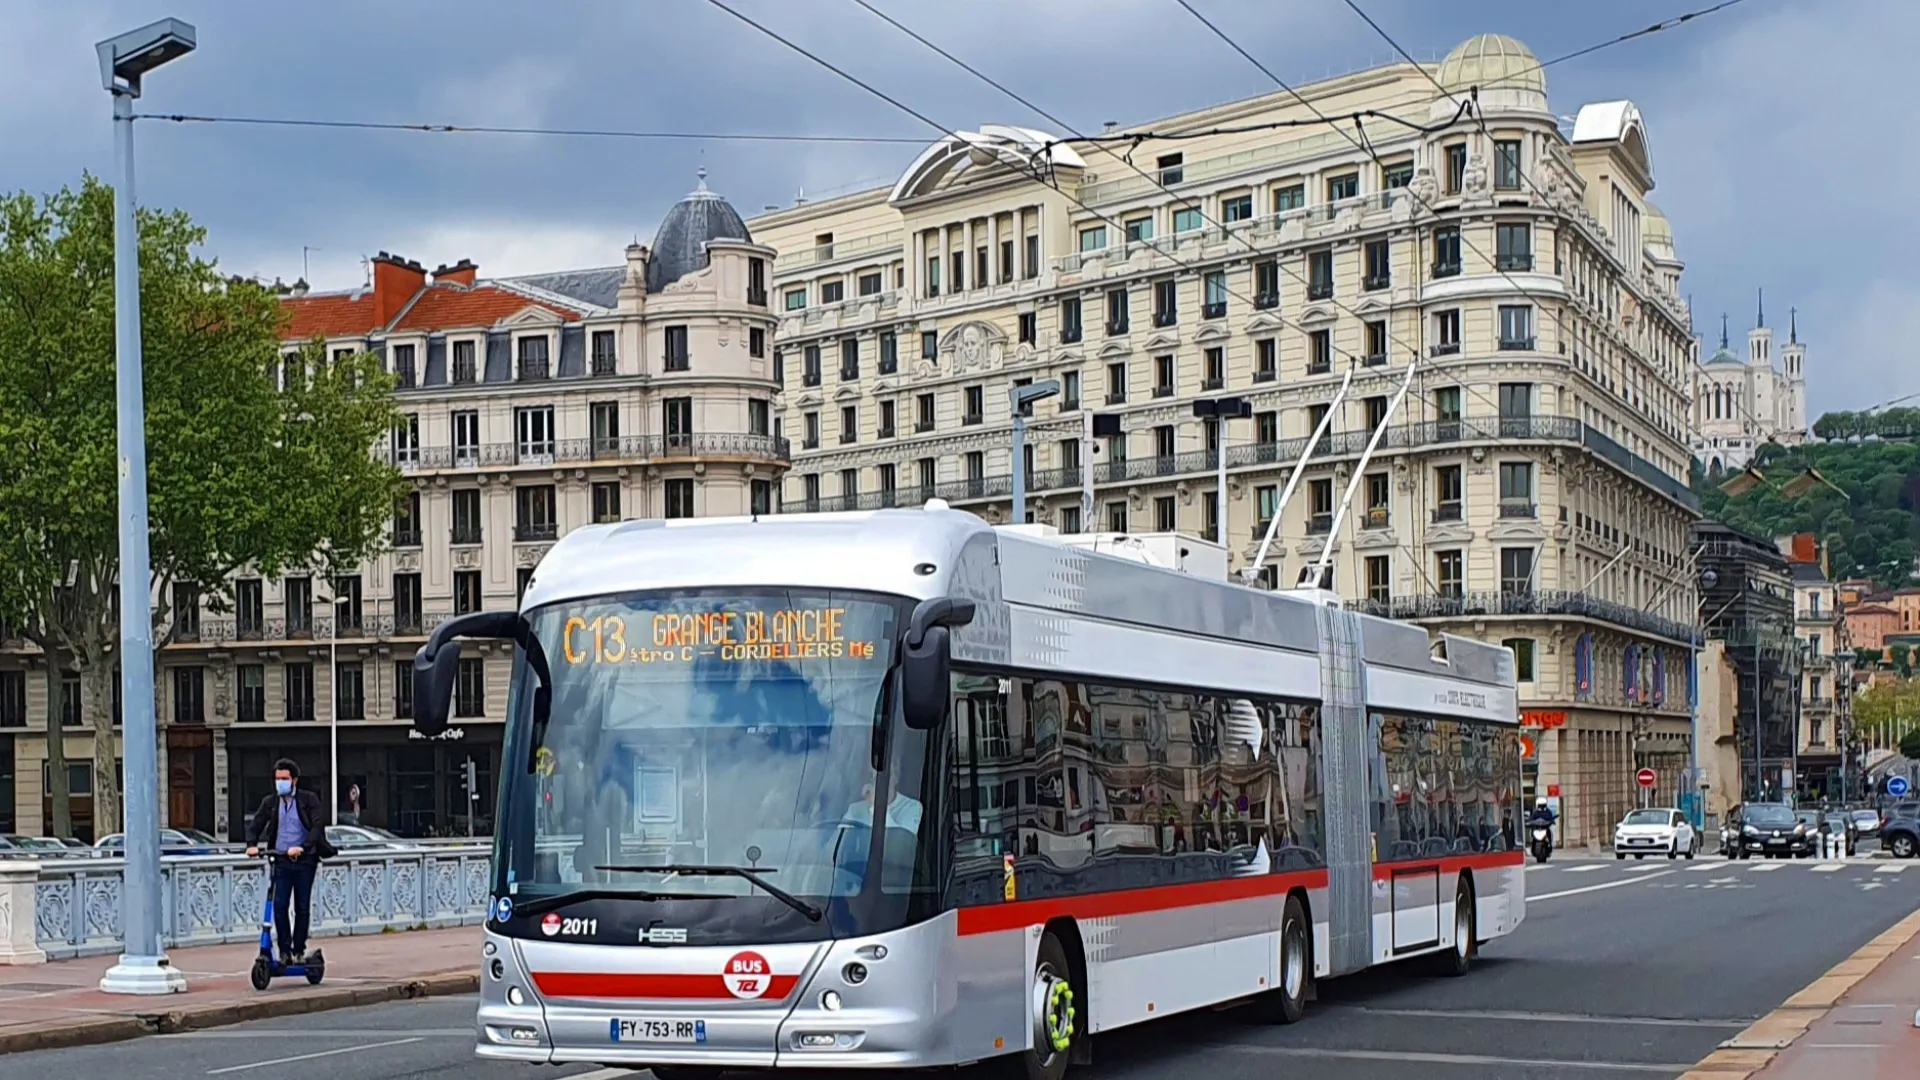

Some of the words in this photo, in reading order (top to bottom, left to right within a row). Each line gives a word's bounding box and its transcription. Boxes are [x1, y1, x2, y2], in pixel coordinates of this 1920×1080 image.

[653, 611, 737, 647] GRANGE
[744, 608, 845, 645] BLANCHE
[563, 615, 626, 665] C13
[682, 646, 693, 661] C
[721, 642, 843, 661] CORDELIERS
[562, 918, 597, 935] 2011
[638, 928, 688, 942] HESS
[733, 959, 762, 973] BUS
[620, 1020, 694, 1038] FY-753-RR
